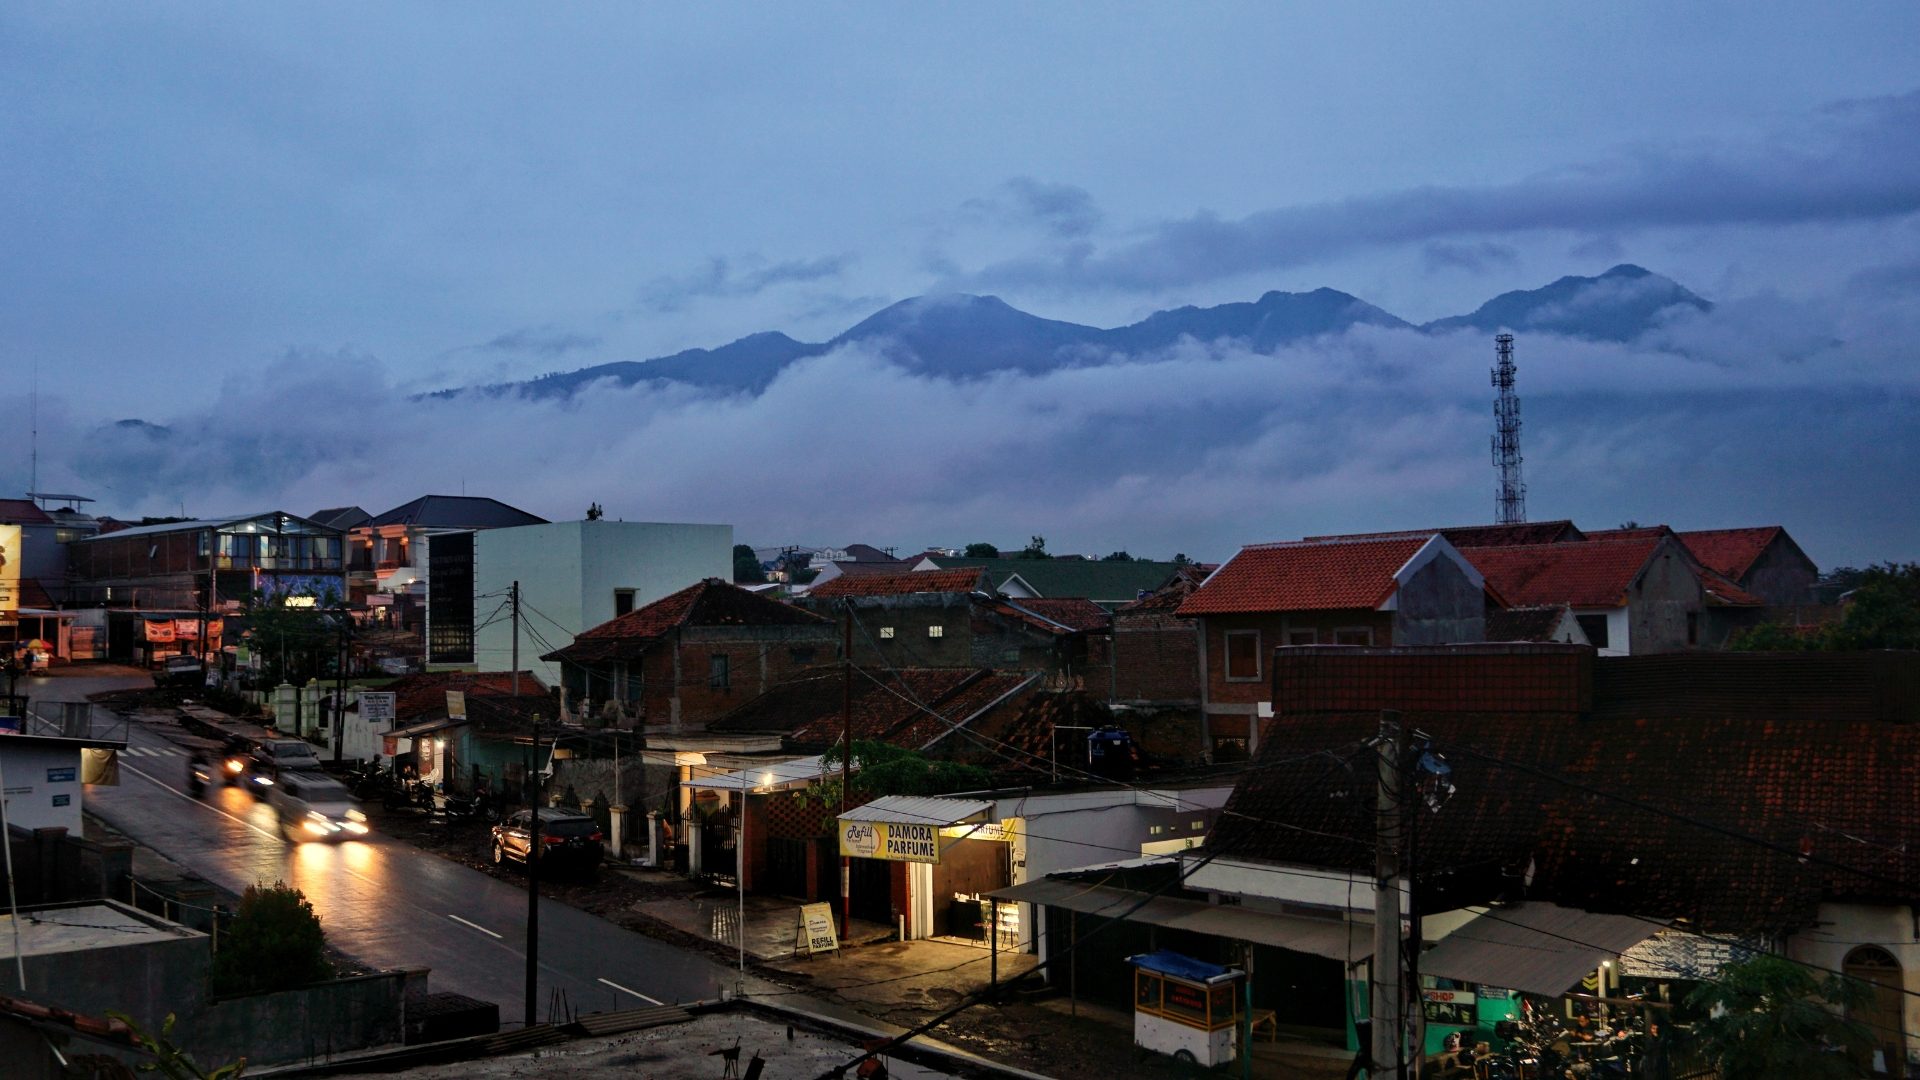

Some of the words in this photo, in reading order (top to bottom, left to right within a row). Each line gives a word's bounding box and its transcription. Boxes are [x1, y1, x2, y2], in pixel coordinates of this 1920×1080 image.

[847, 825, 873, 841] Refill
[888, 825, 933, 841] DAMORA
[887, 840, 935, 857] PARFUME
[811, 936, 832, 944] REFILL
[1430, 991, 1454, 1001] SHOP
